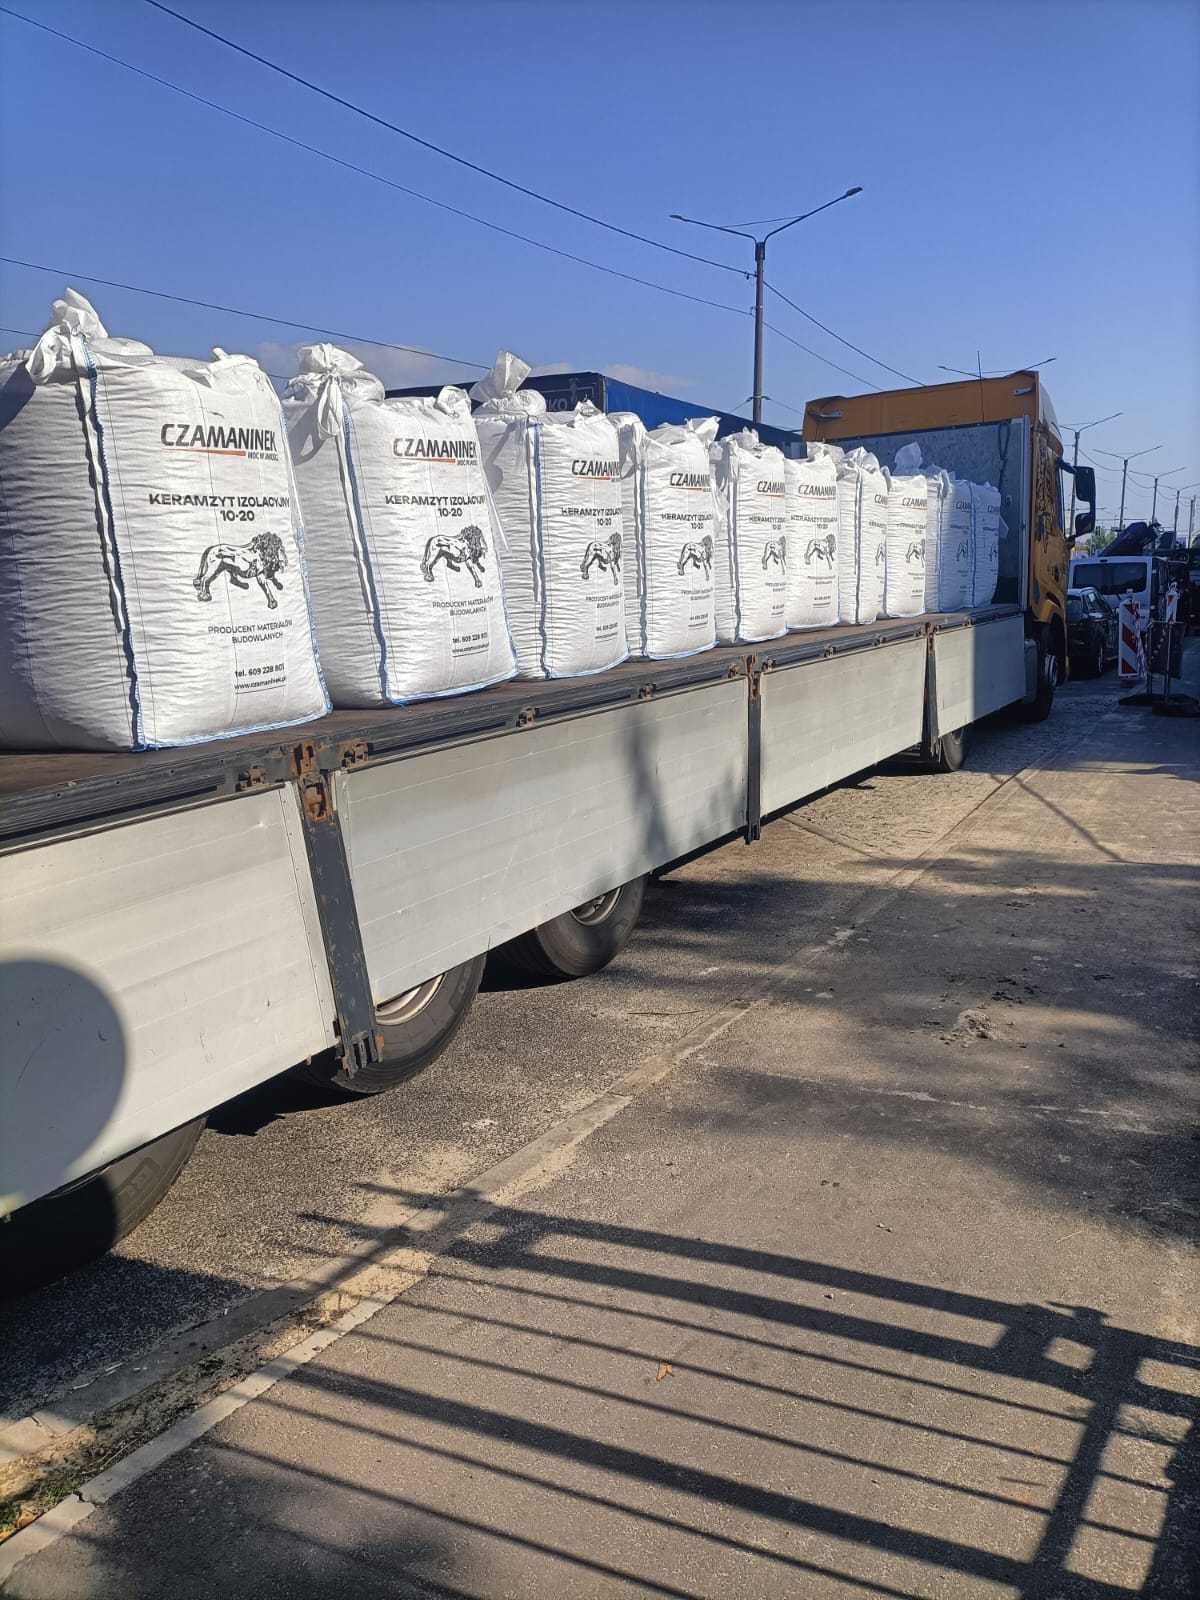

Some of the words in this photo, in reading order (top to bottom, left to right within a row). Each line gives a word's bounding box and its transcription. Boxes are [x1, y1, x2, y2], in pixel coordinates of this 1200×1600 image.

[160, 423, 278, 452] CZAMANINEK
[393, 438, 477, 458] CZAMANINEK
[149, 493, 235, 507] KERAMZYT
[237, 496, 290, 508] IZOLACYJNY
[385, 495, 448, 505] KERAMZYT
[208, 624, 256, 634] PRODUCENT
[232, 632, 284, 644] BUDOWLANYCH
